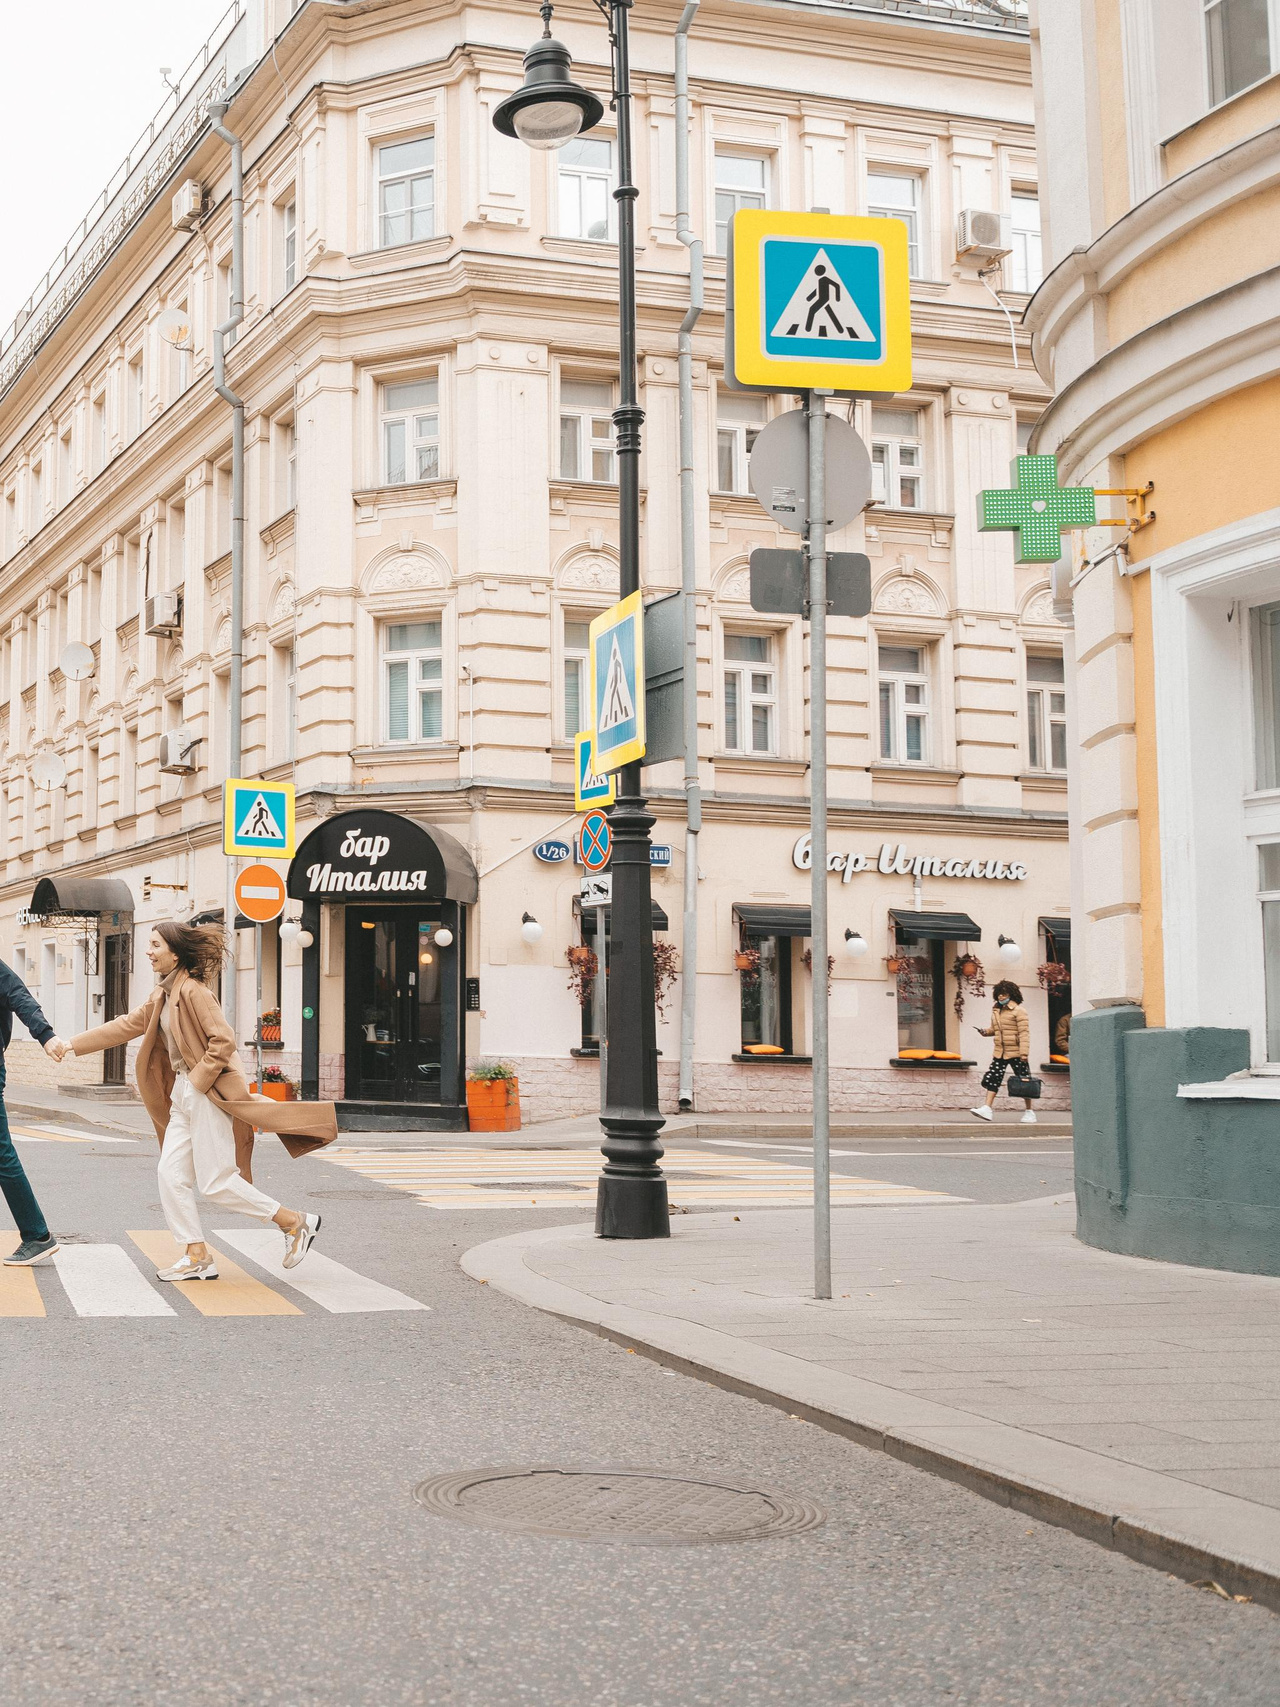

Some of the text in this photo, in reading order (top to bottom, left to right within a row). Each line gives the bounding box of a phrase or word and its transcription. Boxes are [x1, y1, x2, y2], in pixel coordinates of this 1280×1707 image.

[340, 828, 390, 865] бар
[541, 844, 567, 859] 1/26
[878, 843, 1029, 881] Италия
[306, 863, 427, 892] Италия
